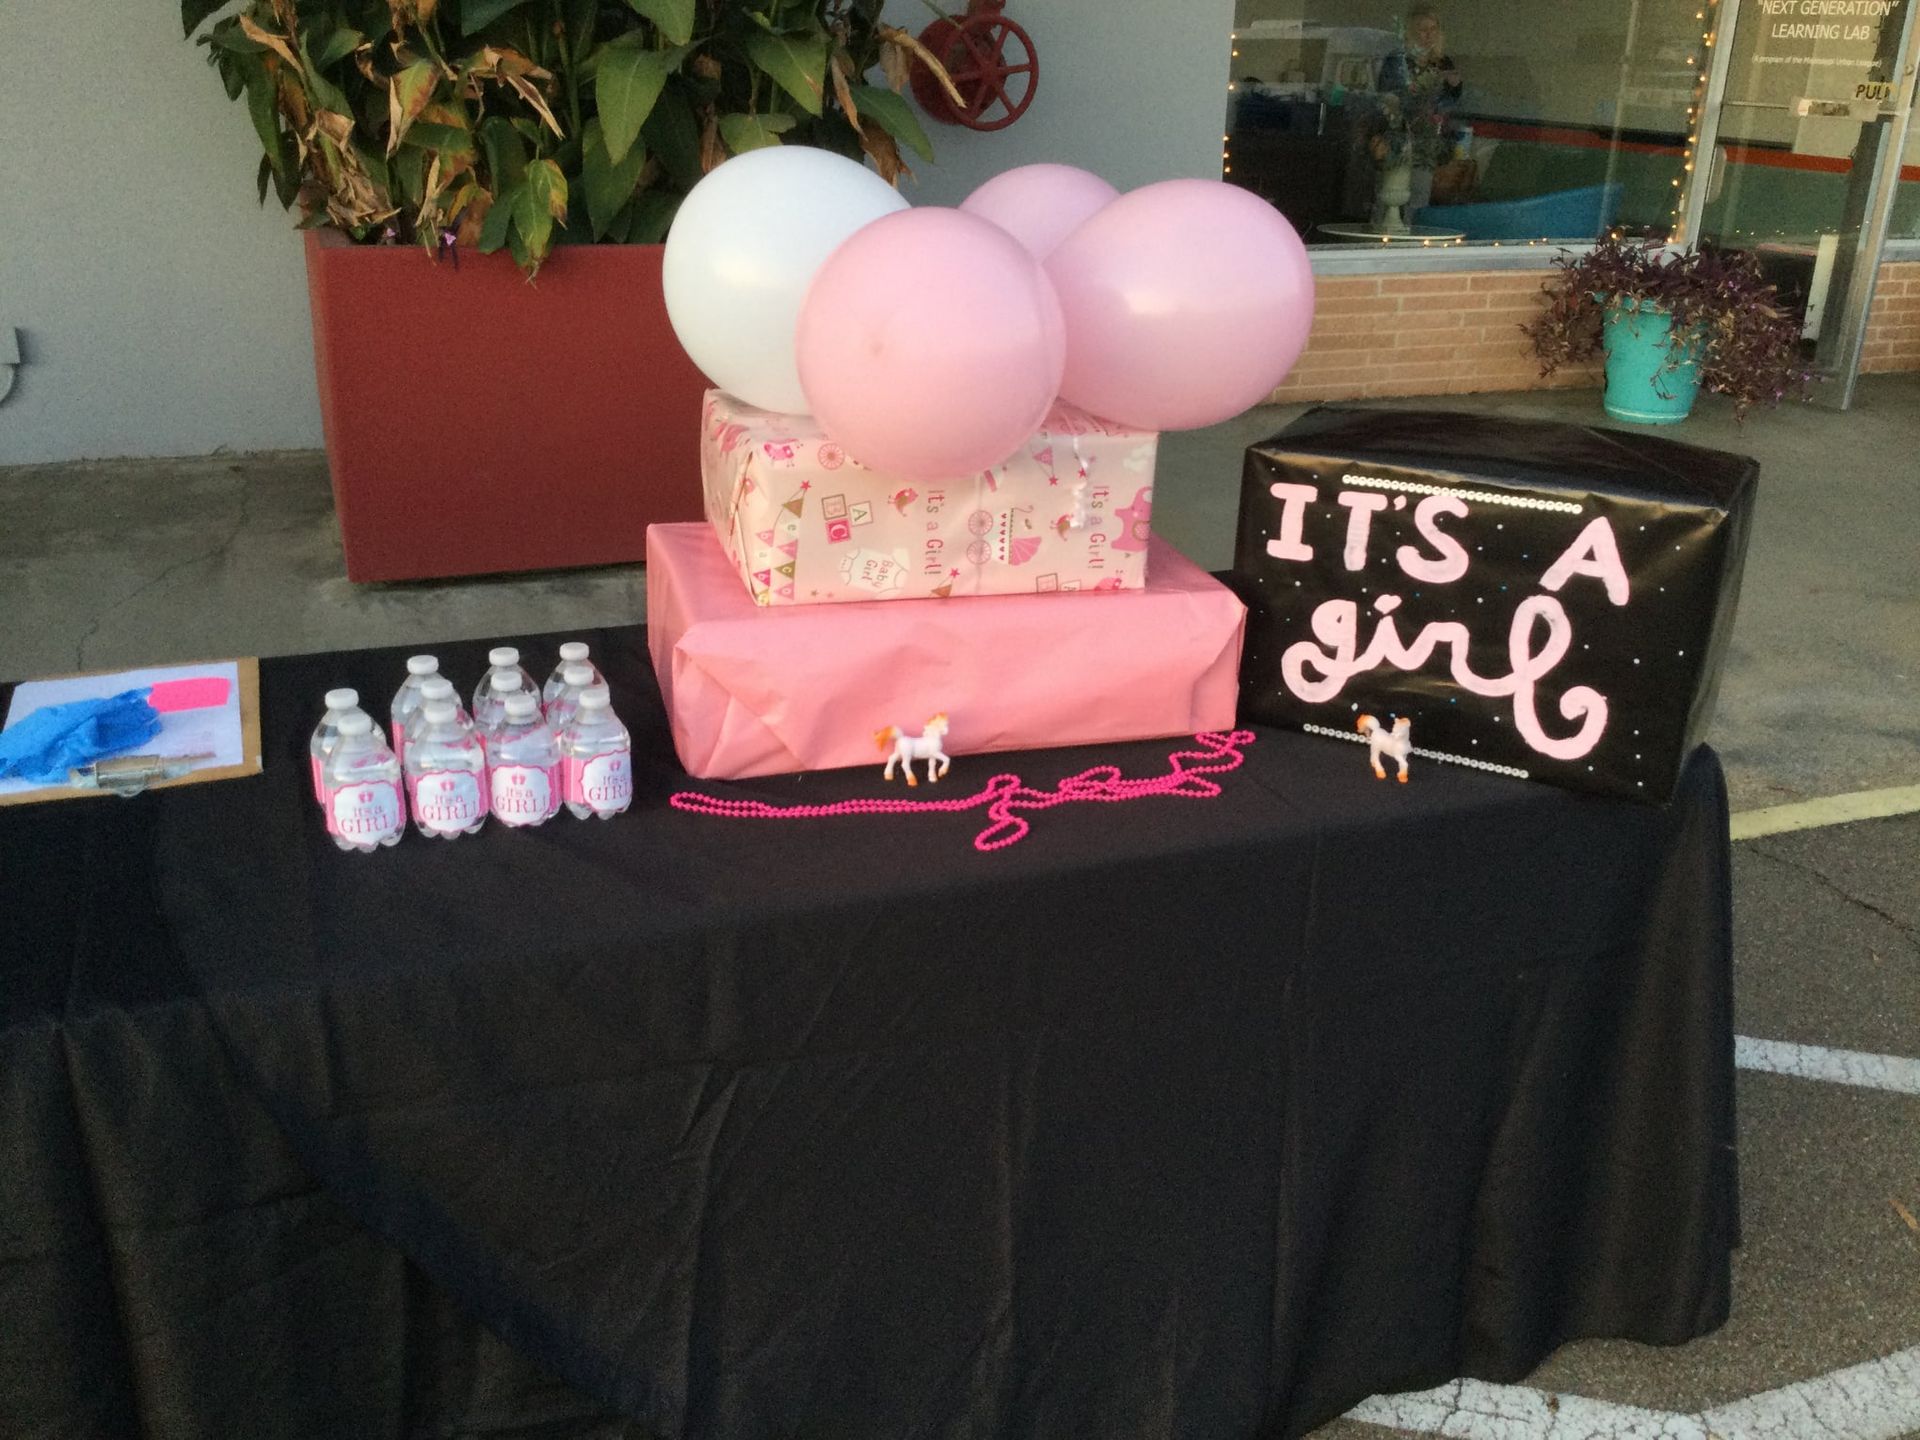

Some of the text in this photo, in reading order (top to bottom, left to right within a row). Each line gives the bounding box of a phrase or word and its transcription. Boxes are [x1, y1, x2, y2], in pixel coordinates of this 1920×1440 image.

[1772, 23, 1871, 40] LEARNING LAB
[1266, 482, 1630, 606] IT'S A
[1281, 594, 1608, 760] girl
